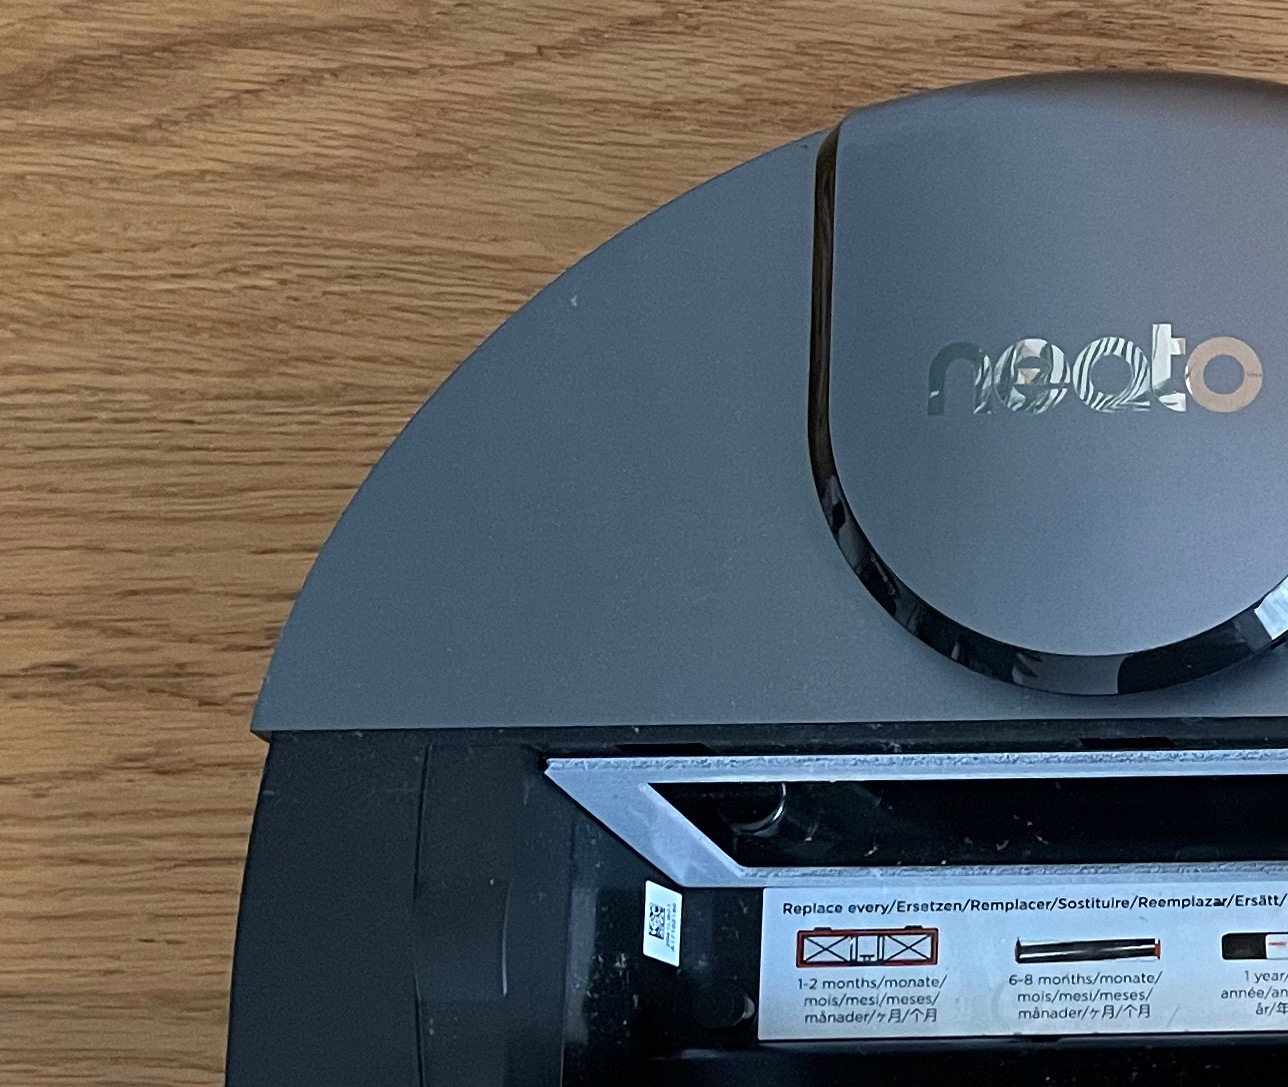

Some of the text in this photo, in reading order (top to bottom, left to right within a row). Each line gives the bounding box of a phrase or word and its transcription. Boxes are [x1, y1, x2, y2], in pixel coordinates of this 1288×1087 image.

[926, 322, 1264, 397] neato
[782, 902, 843, 917] Replace
[797, 974, 948, 990] 1-2 months/monate/
[1008, 970, 1164, 986] 6-8 months/monate/
[803, 991, 941, 1008] mois/mesi/meses/
[1017, 987, 1154, 1003] mois/mesi/meses/
